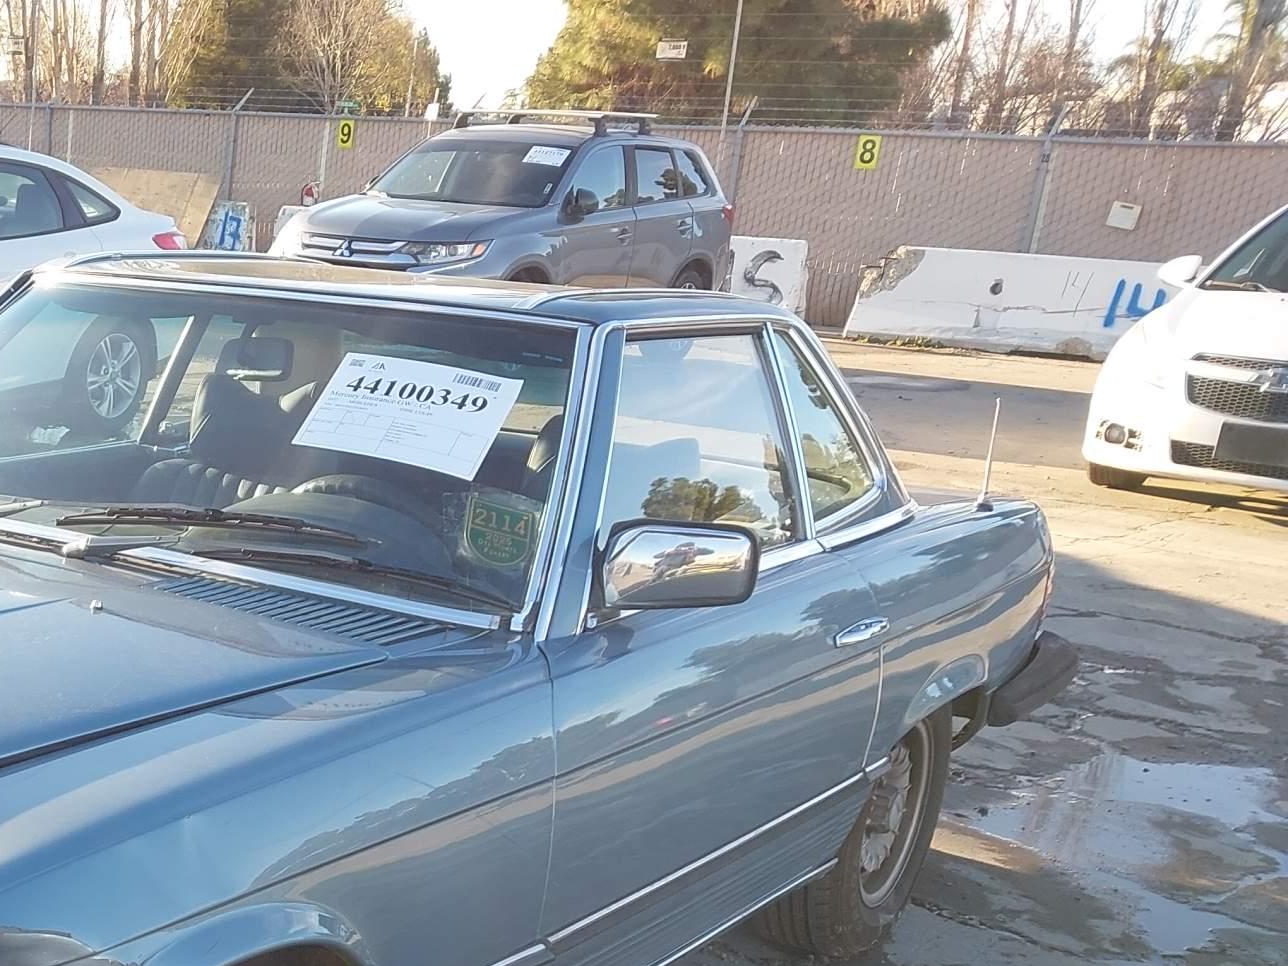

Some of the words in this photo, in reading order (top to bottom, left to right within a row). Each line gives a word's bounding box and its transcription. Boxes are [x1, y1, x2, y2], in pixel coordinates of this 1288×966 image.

[340, 122, 352, 144] 9
[859, 139, 876, 164] 8
[345, 375, 489, 413] 44100349
[474, 508, 526, 536] 2114
